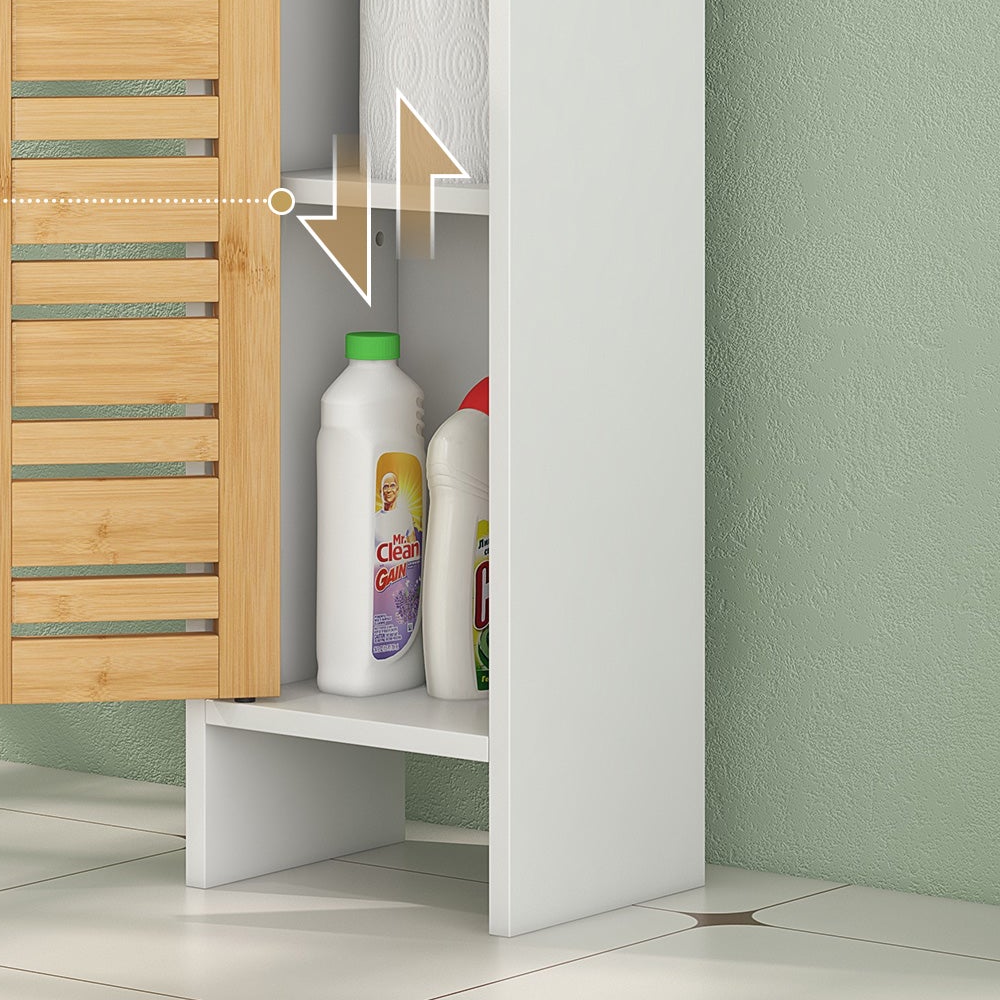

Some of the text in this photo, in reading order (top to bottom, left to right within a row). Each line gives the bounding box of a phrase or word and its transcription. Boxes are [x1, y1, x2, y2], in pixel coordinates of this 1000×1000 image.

[393, 534, 407, 545] Mr.
[376, 541, 420, 562] Clean
[375, 562, 407, 592] GAIN
